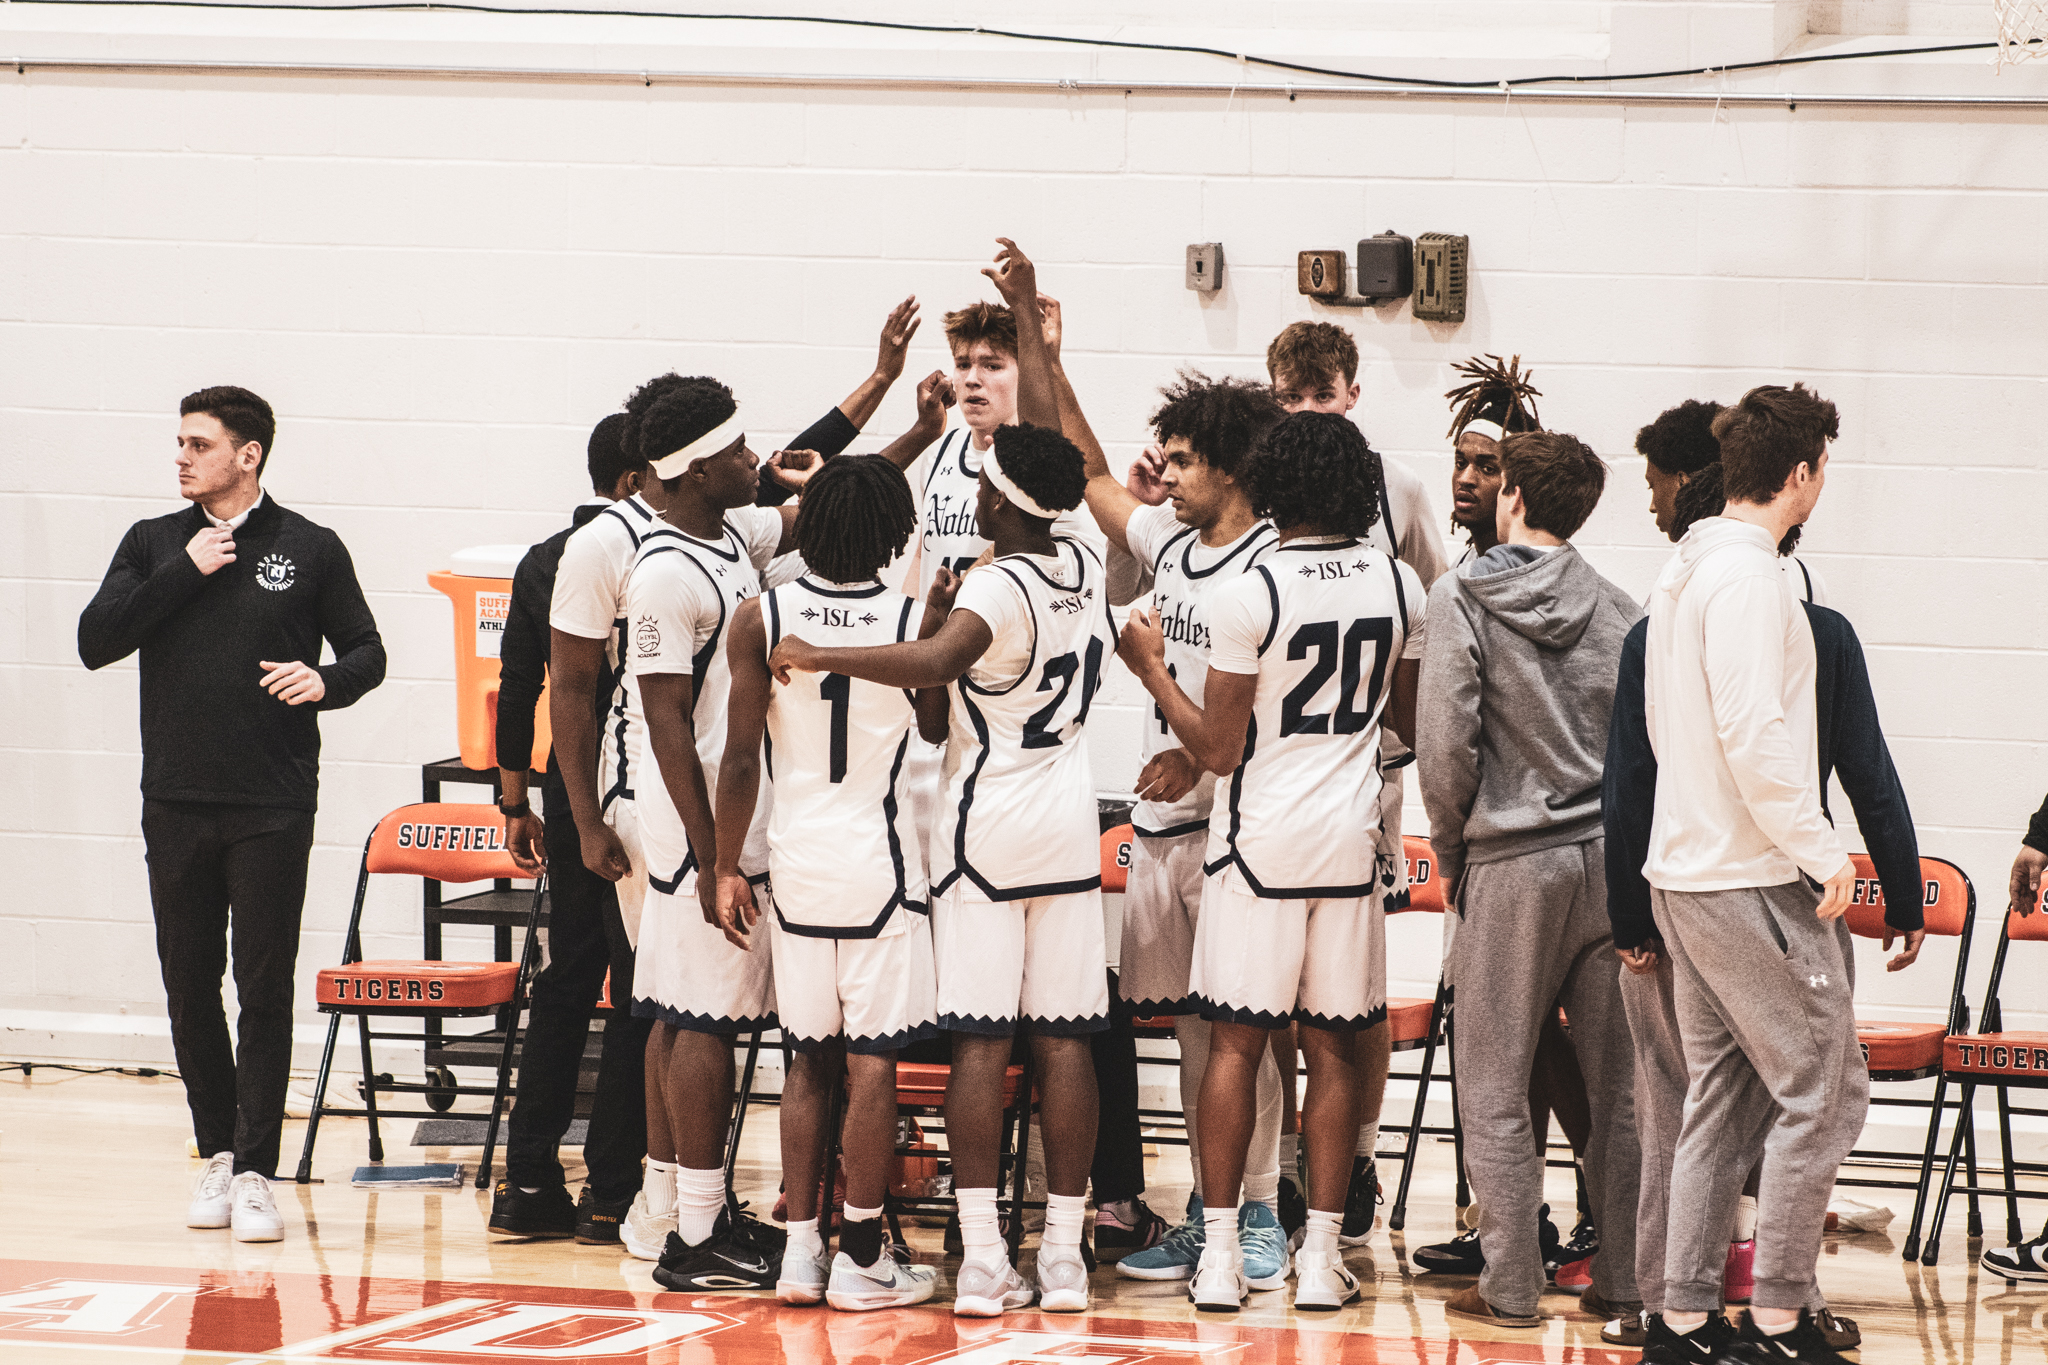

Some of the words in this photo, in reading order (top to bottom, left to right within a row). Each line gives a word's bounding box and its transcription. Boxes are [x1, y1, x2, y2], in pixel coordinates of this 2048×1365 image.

[923, 493, 979, 552] Nobl
[257, 553, 296, 571] NOBLES
[1316, 561, 1351, 581] ISL
[255, 573, 295, 591] BASKETBALL
[479, 597, 511, 609] SUFF
[1061, 595, 1086, 615] ISL
[821, 607, 856, 628] ISL
[1279, 616, 1394, 738] 20
[820, 671, 851, 784] 1
[397, 823, 509, 852] SUFFIEL
[334, 978, 445, 1001] TIGERS
